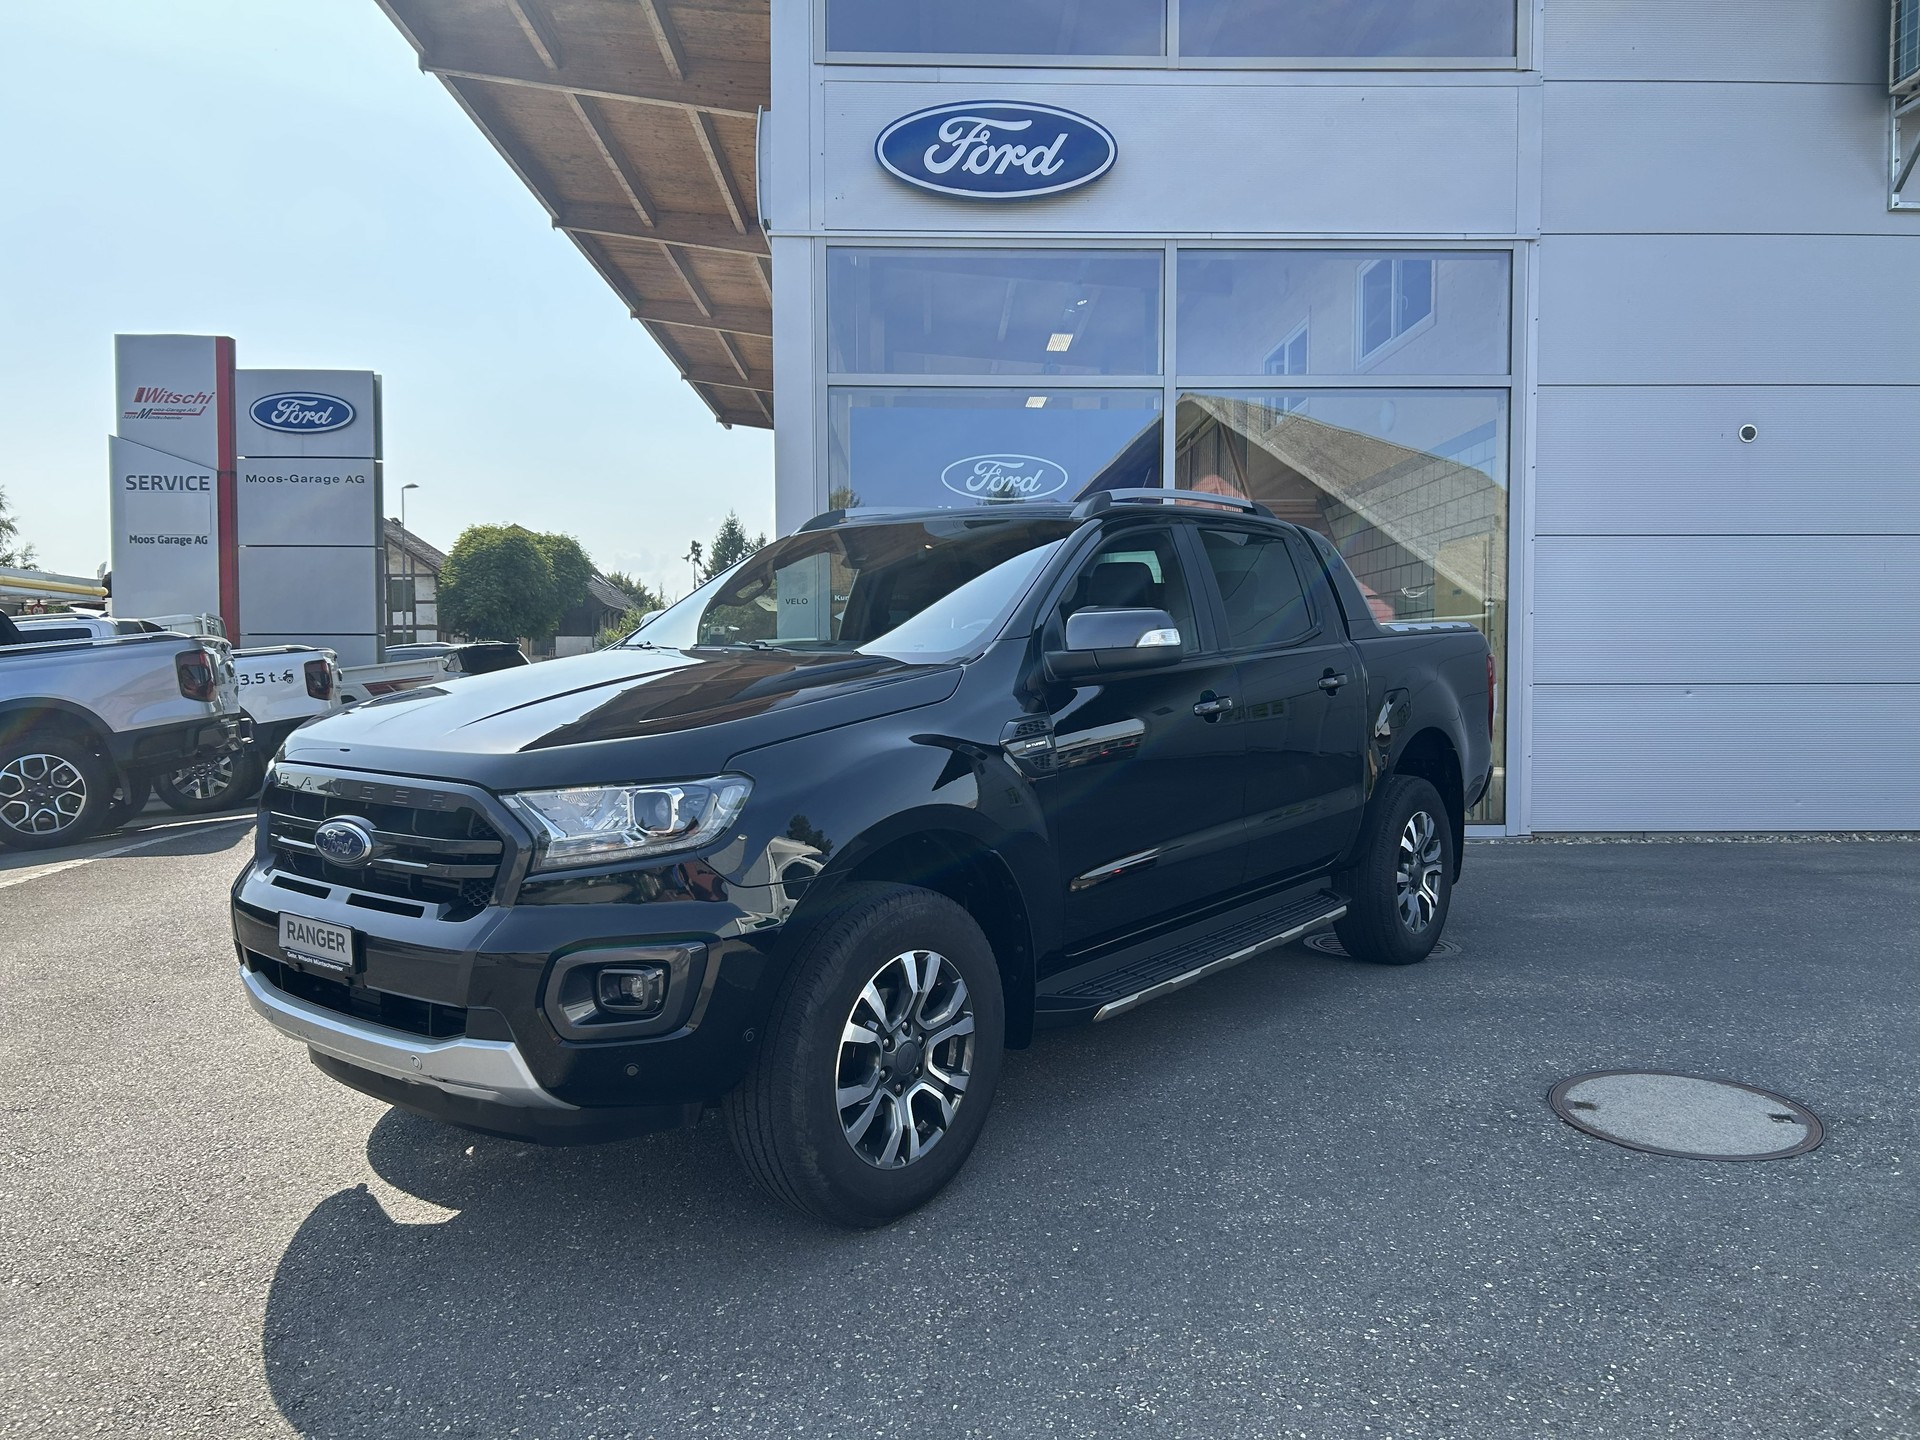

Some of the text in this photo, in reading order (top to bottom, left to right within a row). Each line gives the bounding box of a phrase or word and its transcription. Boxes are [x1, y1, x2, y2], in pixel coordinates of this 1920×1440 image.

[923, 115, 1069, 177] Ford
[143, 387, 215, 404] Witschi
[271, 398, 335, 426] Ford
[125, 475, 211, 492] SERVICE
[244, 473, 365, 486] Moos-Garage AG
[965, 460, 1044, 493] Ford
[129, 535, 208, 547] Moos Garage AG
[785, 597, 809, 605] VELO
[240, 671, 277, 686] 3.5 t
[321, 829, 354, 855] Ford
[287, 920, 346, 953] RANGER
